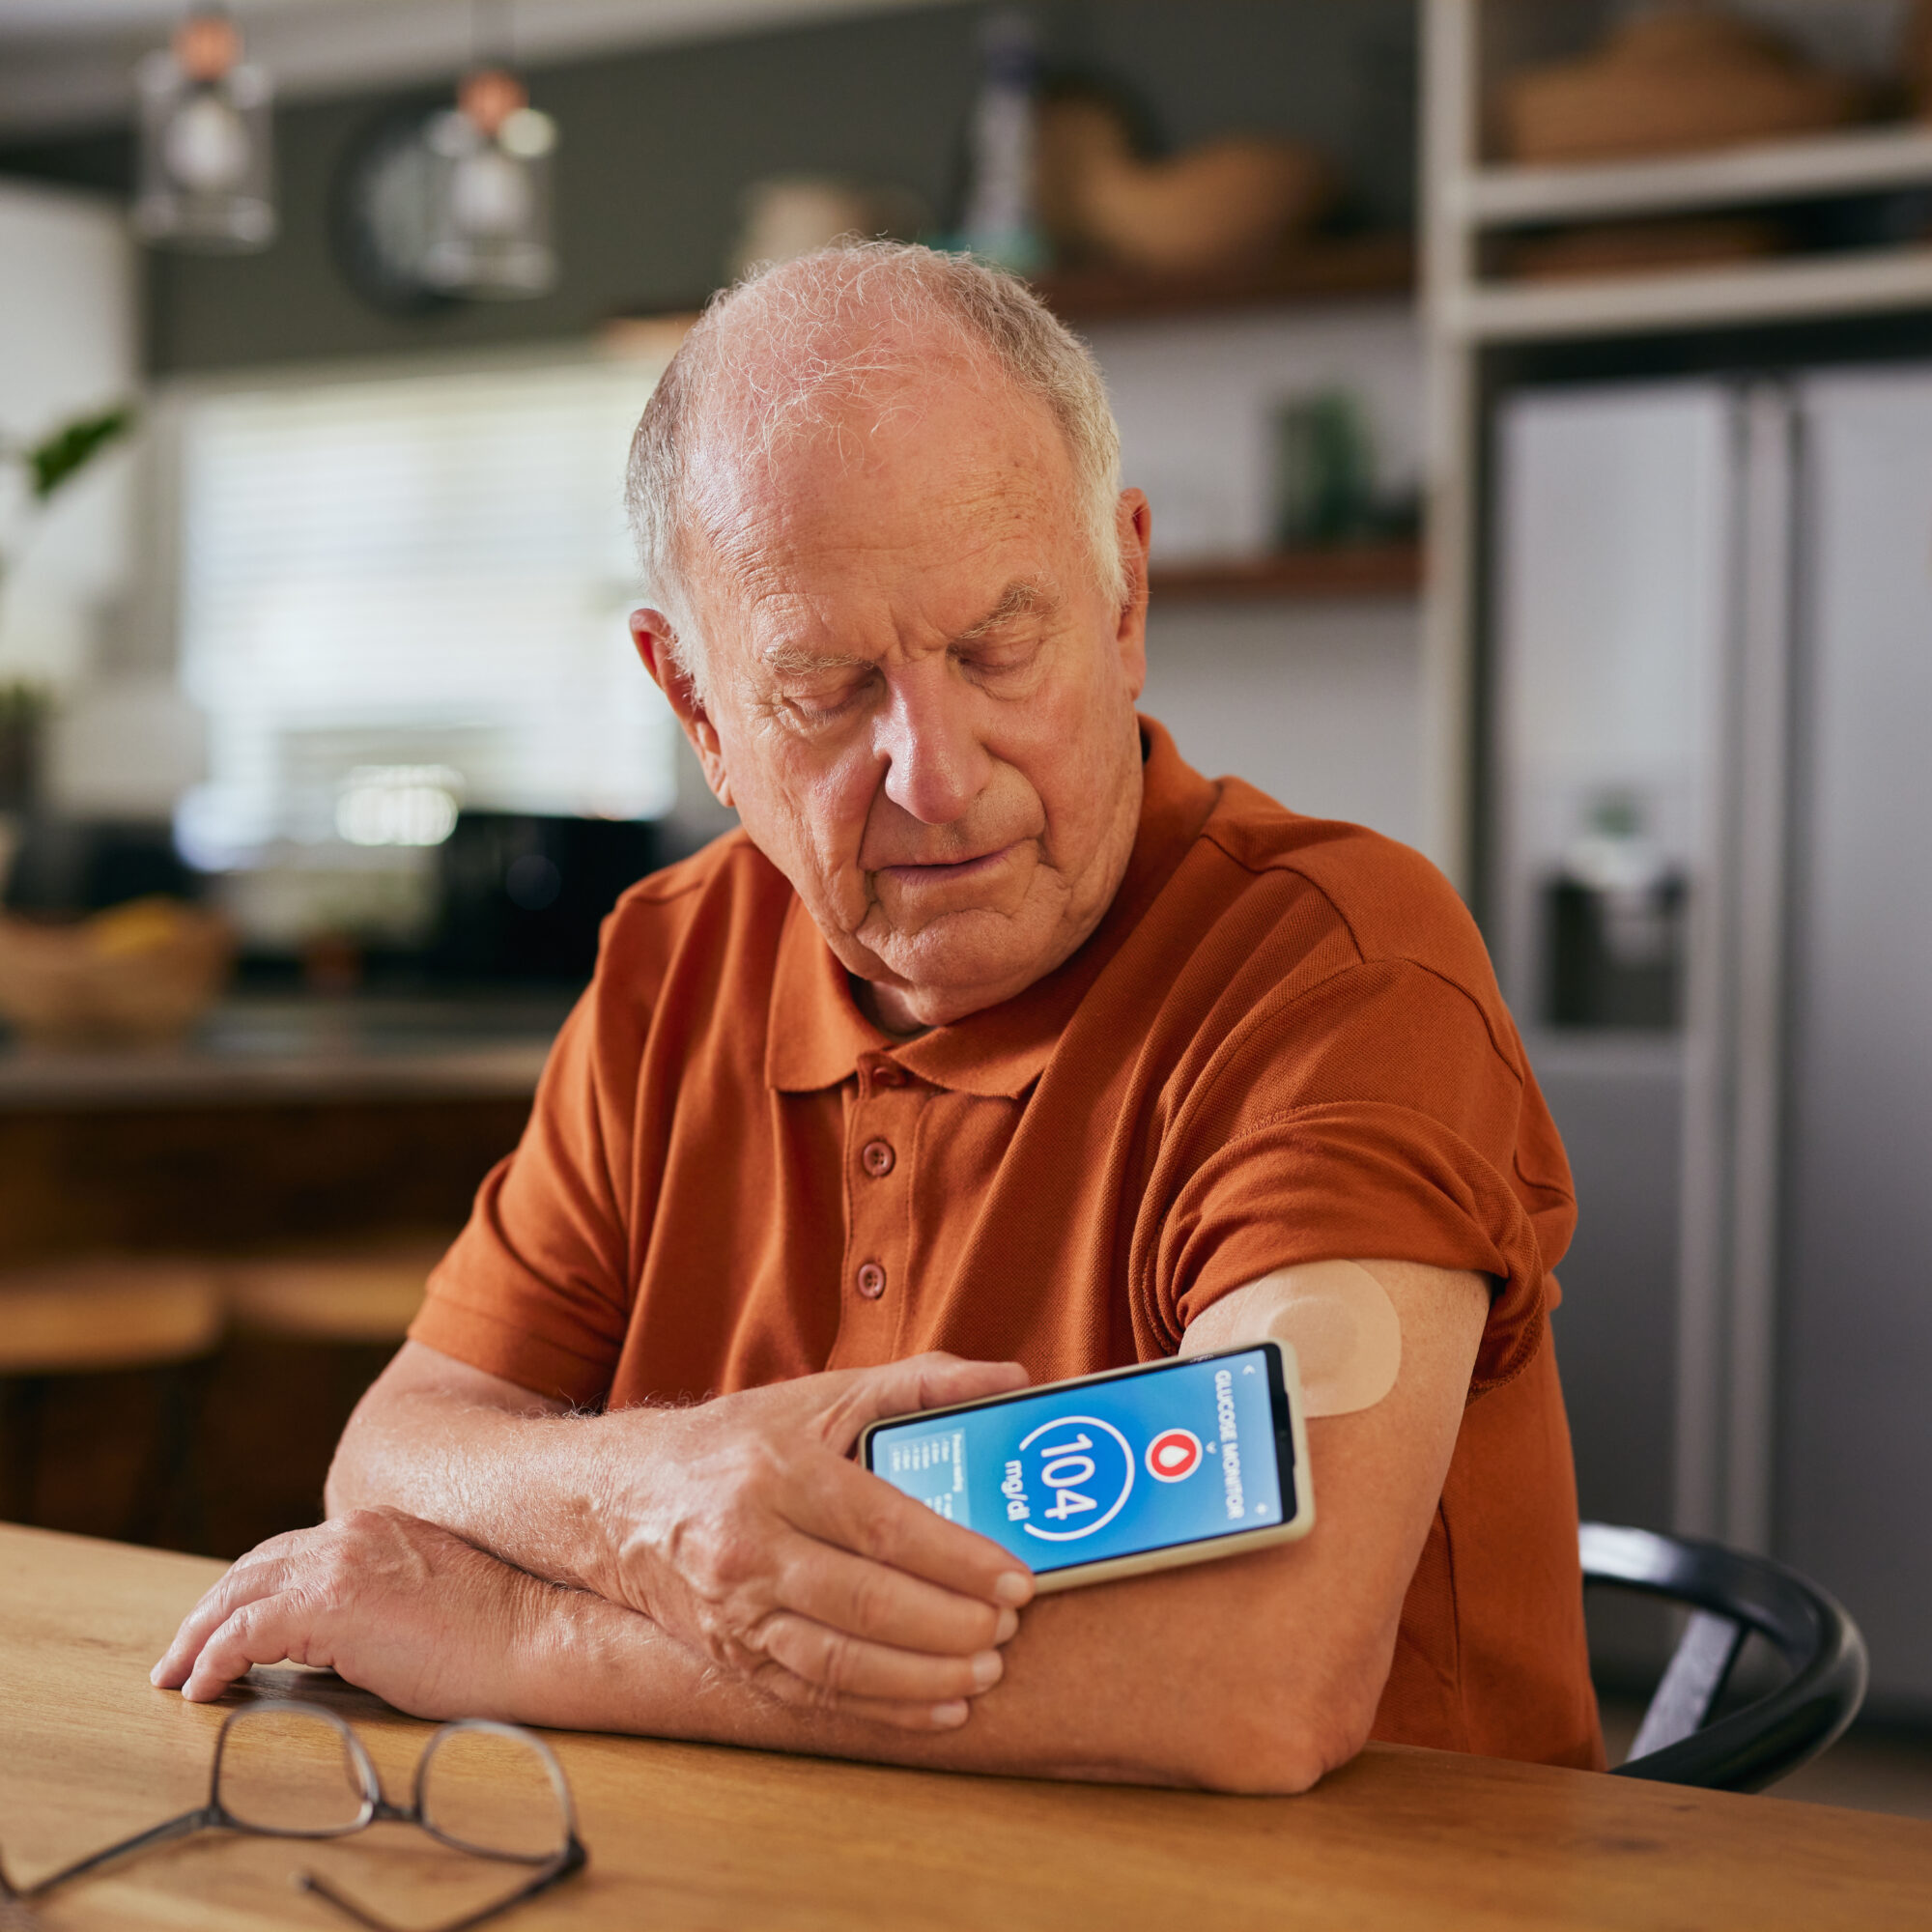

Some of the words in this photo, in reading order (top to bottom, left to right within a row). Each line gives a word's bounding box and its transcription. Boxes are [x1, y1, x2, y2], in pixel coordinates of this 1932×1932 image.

[1214, 1369, 1237, 1442] GLUCOSE
[1040, 1433, 1097, 1520] 104
[1222, 1442, 1244, 1520] MONITOR
